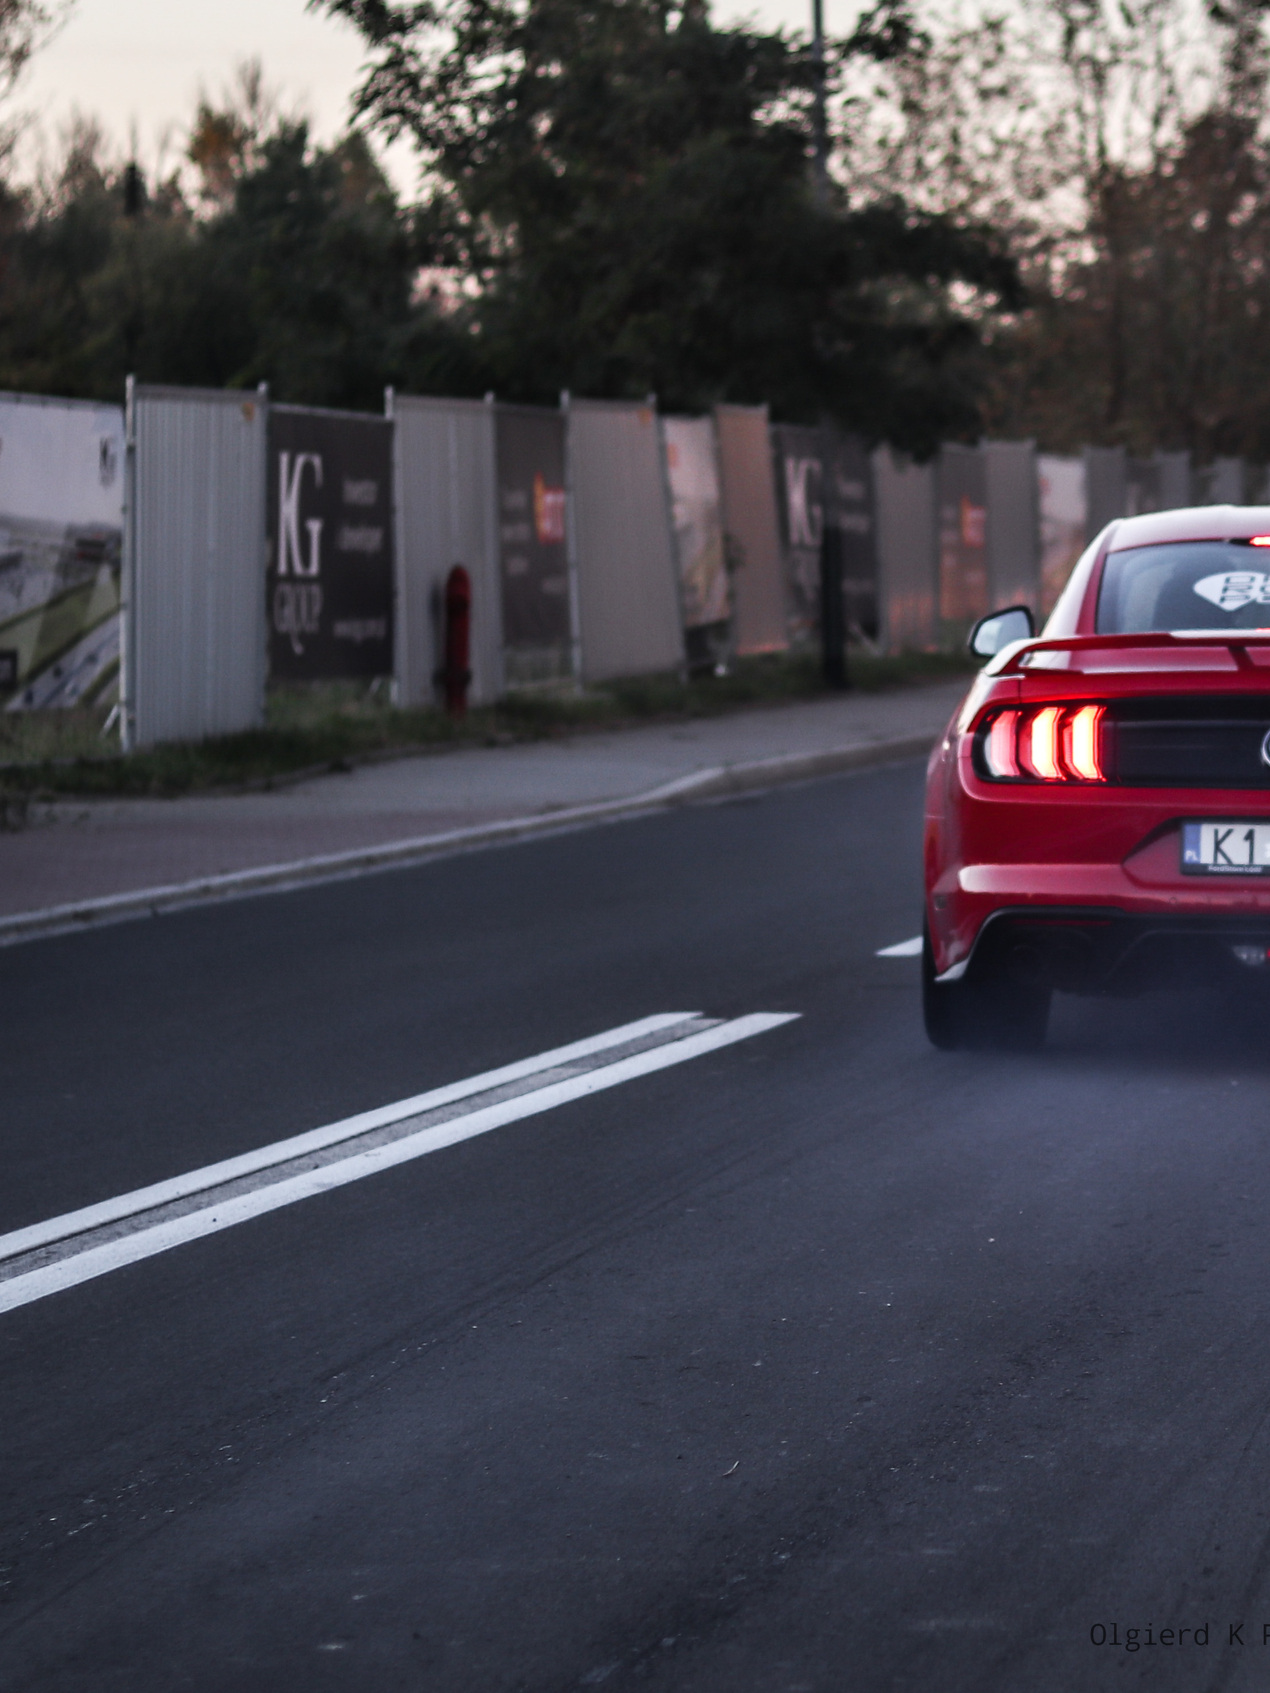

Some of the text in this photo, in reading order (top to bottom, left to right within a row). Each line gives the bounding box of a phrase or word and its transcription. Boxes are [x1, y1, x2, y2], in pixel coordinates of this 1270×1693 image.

[278, 451, 323, 577] KG
[1185, 850, 1198, 861] PL
[1214, 828, 1256, 865] K1
